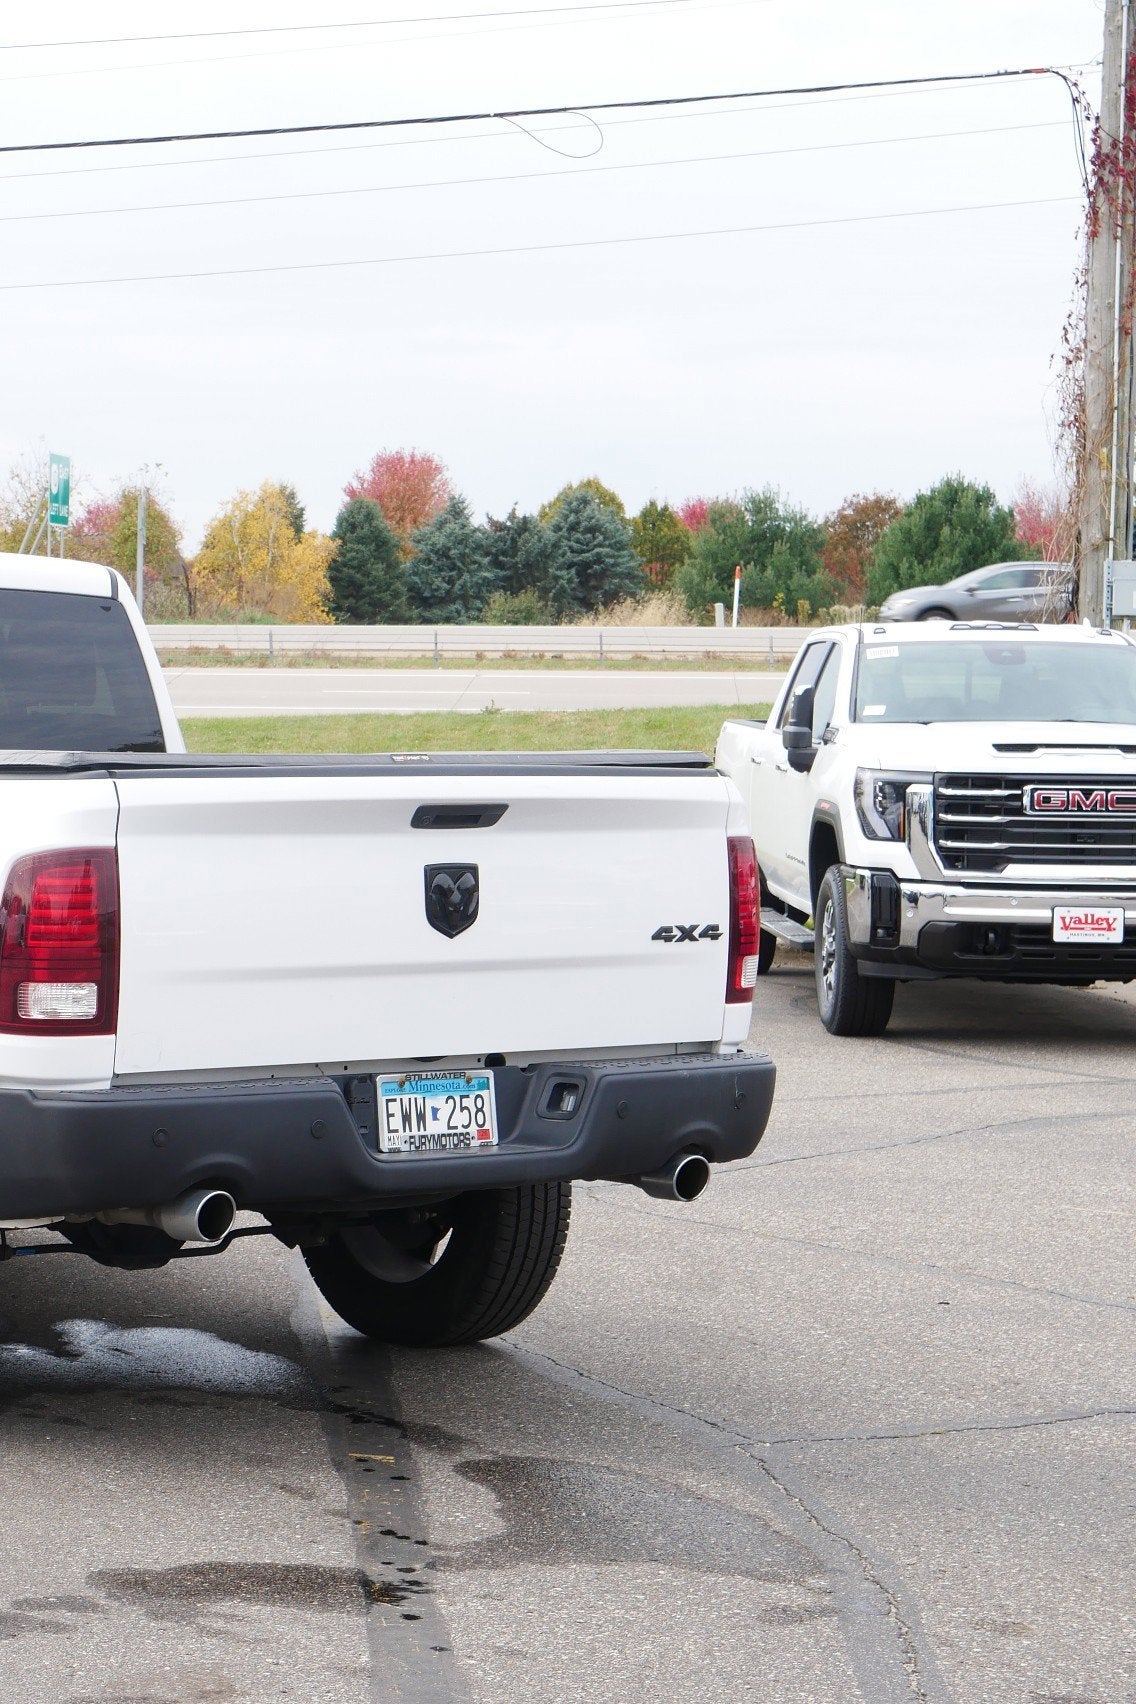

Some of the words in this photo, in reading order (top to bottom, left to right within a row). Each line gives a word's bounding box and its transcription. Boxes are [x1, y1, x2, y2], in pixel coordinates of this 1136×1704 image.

[1034, 790, 1136, 811] GMC
[1060, 913, 1118, 931] Valley
[405, 1071, 467, 1081] STILLWATER
[408, 1079, 461, 1092] Minnesota
[385, 1096, 427, 1134] EWW
[445, 1093, 486, 1131] 258
[387, 1134, 402, 1147] MAY
